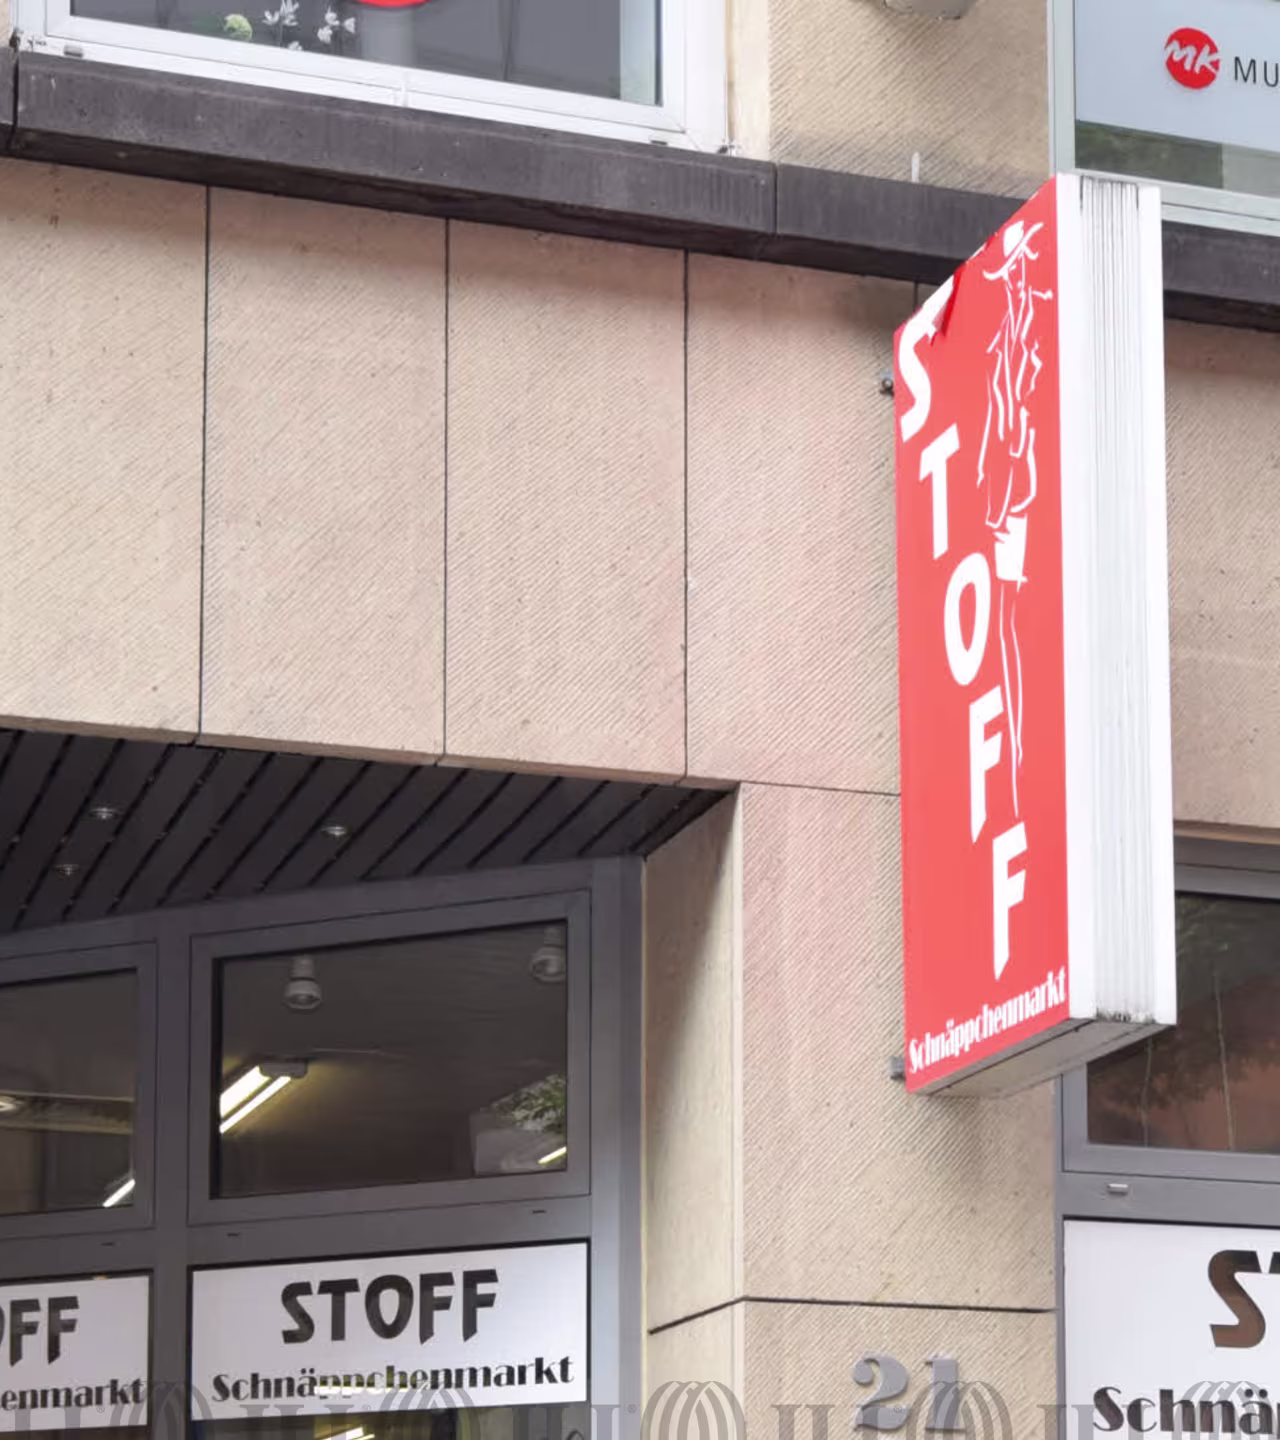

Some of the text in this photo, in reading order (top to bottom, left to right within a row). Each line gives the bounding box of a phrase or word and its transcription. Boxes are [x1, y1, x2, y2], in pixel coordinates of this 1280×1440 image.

[1165, 40, 1220, 74] MK
[898, 274, 1028, 981] STOFF
[909, 965, 1066, 1074] Schnäppchenmarkt
[281, 1268, 499, 1345] STOFF
[211, 1355, 575, 1403] Schnäppchenmarkt
[852, 1353, 966, 1433] 21
